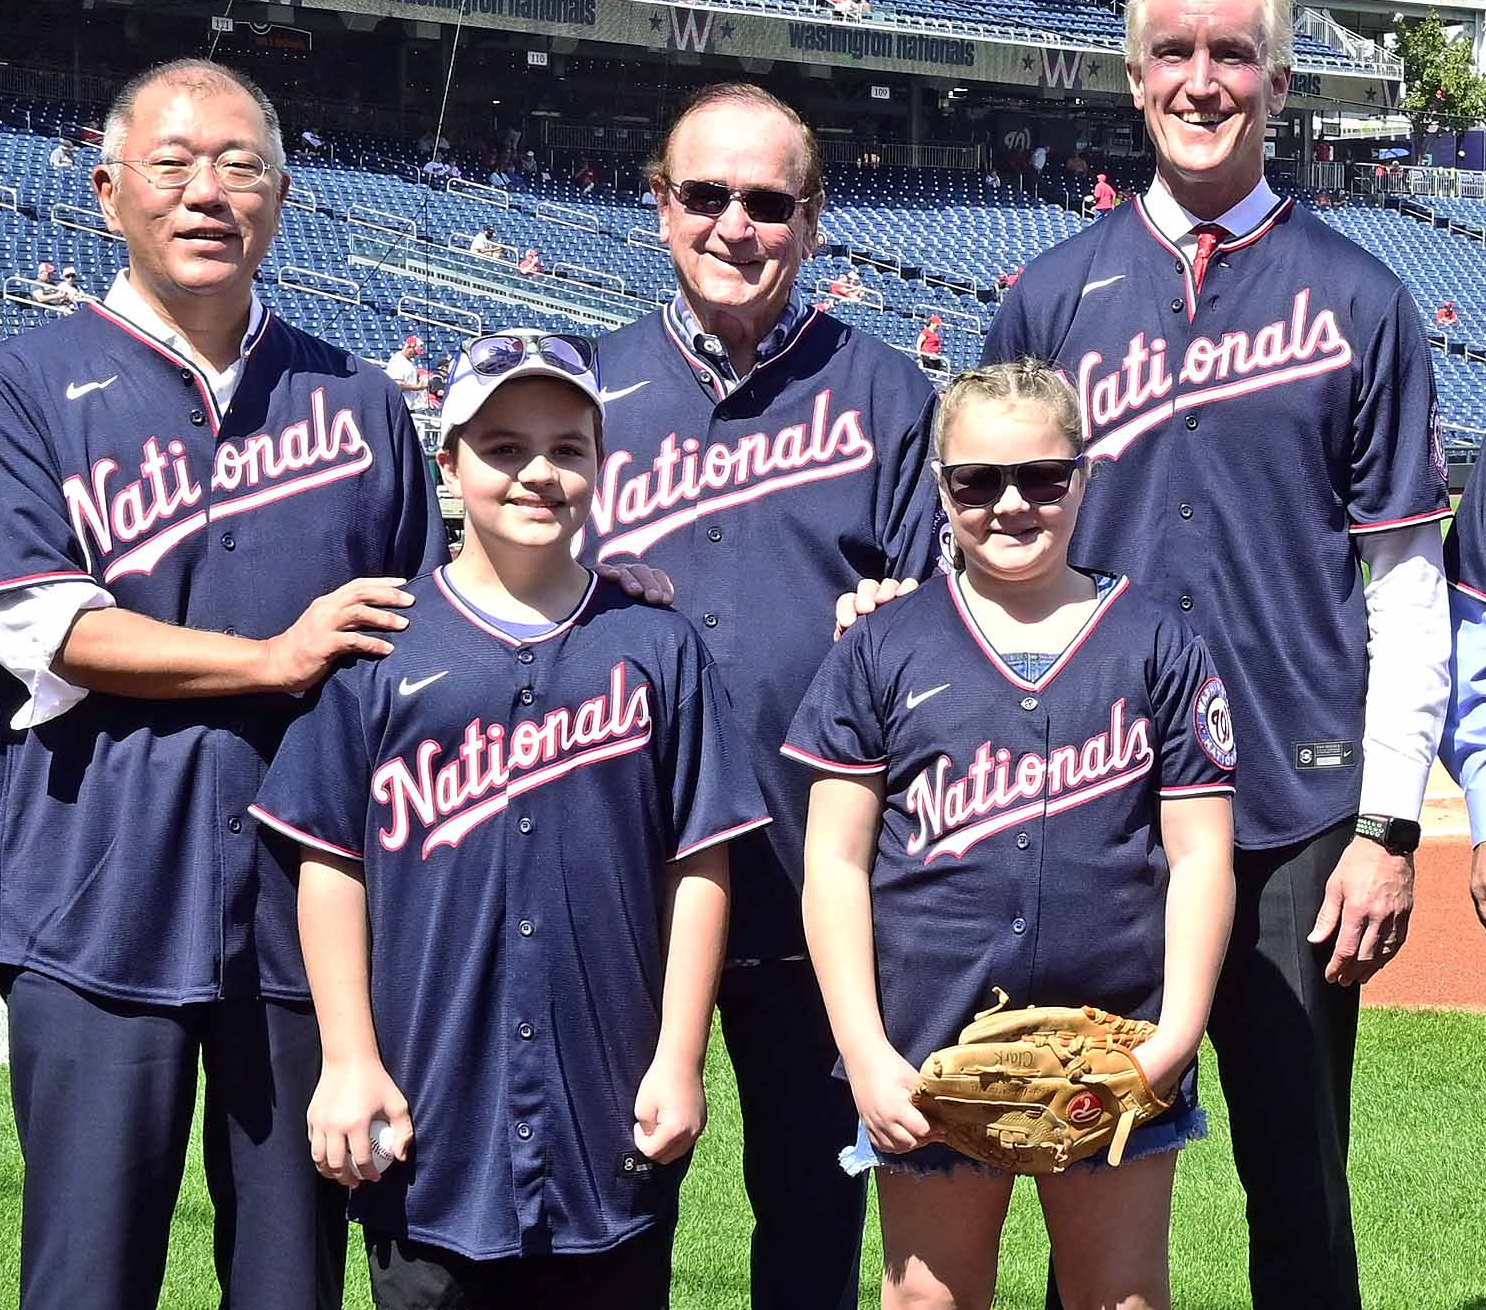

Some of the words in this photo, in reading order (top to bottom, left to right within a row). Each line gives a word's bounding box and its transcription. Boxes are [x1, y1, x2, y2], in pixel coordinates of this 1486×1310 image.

[671, 6, 715, 52] W
[1042, 50, 1083, 89] W
[63, 388, 372, 585] Nationals
[371, 660, 653, 859] Nationals
[907, 696, 1155, 864] Nationals
[993, 1050, 1034, 1066] Clark
